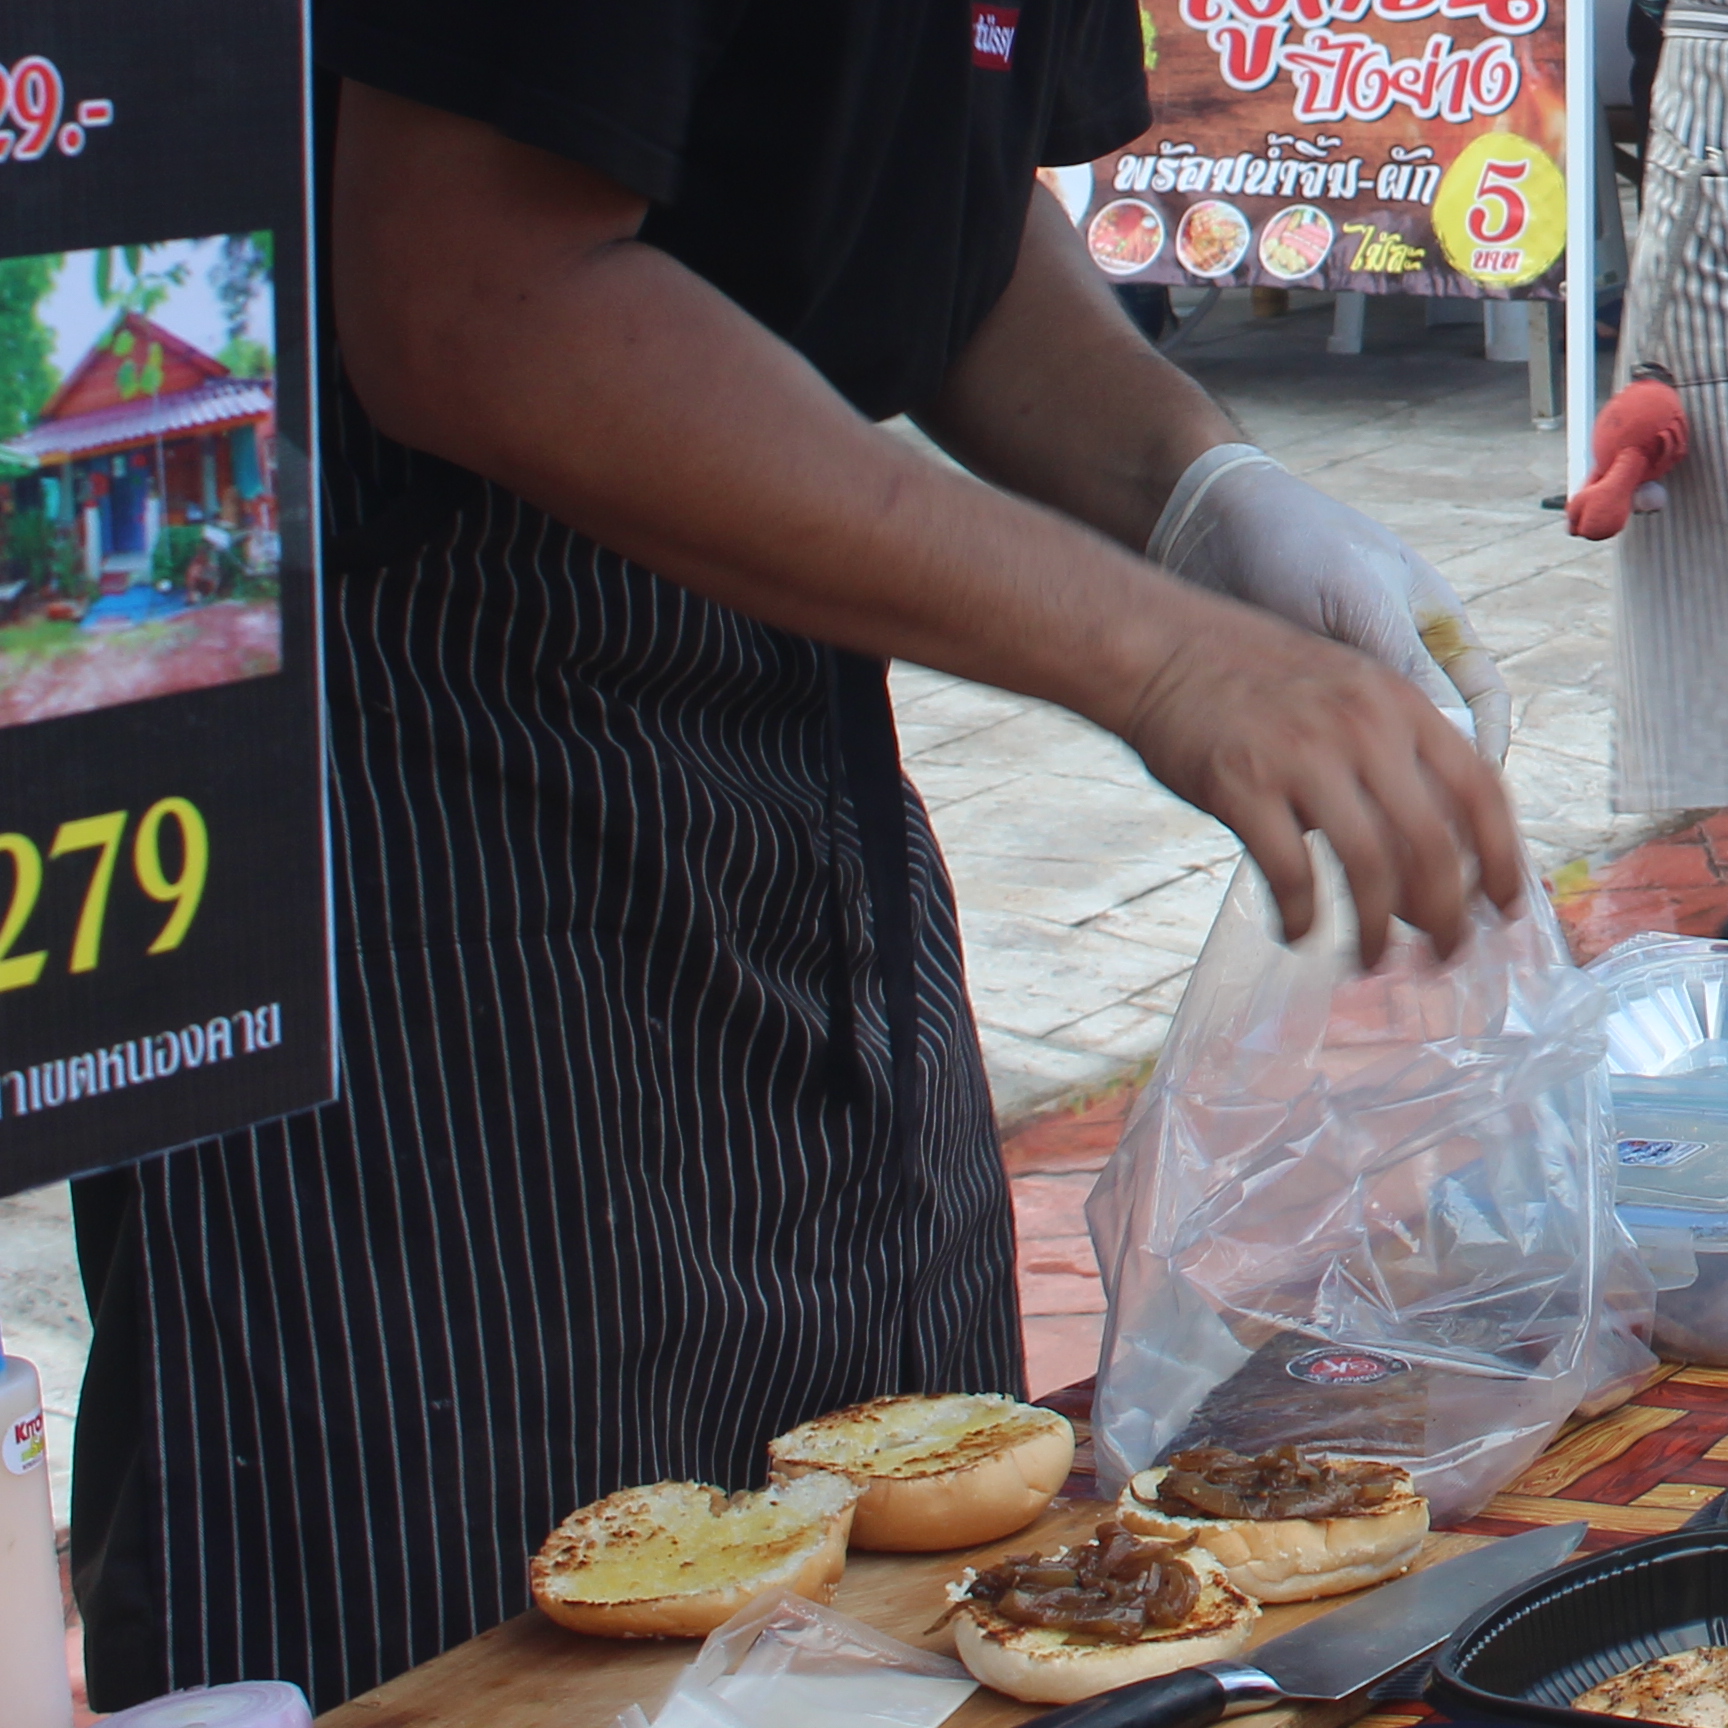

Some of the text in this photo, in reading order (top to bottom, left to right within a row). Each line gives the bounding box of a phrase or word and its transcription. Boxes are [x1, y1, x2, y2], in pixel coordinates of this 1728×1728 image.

[1279, 28, 1521, 123] ปิ้งย่าง
[1466, 158, 1530, 246] 5
